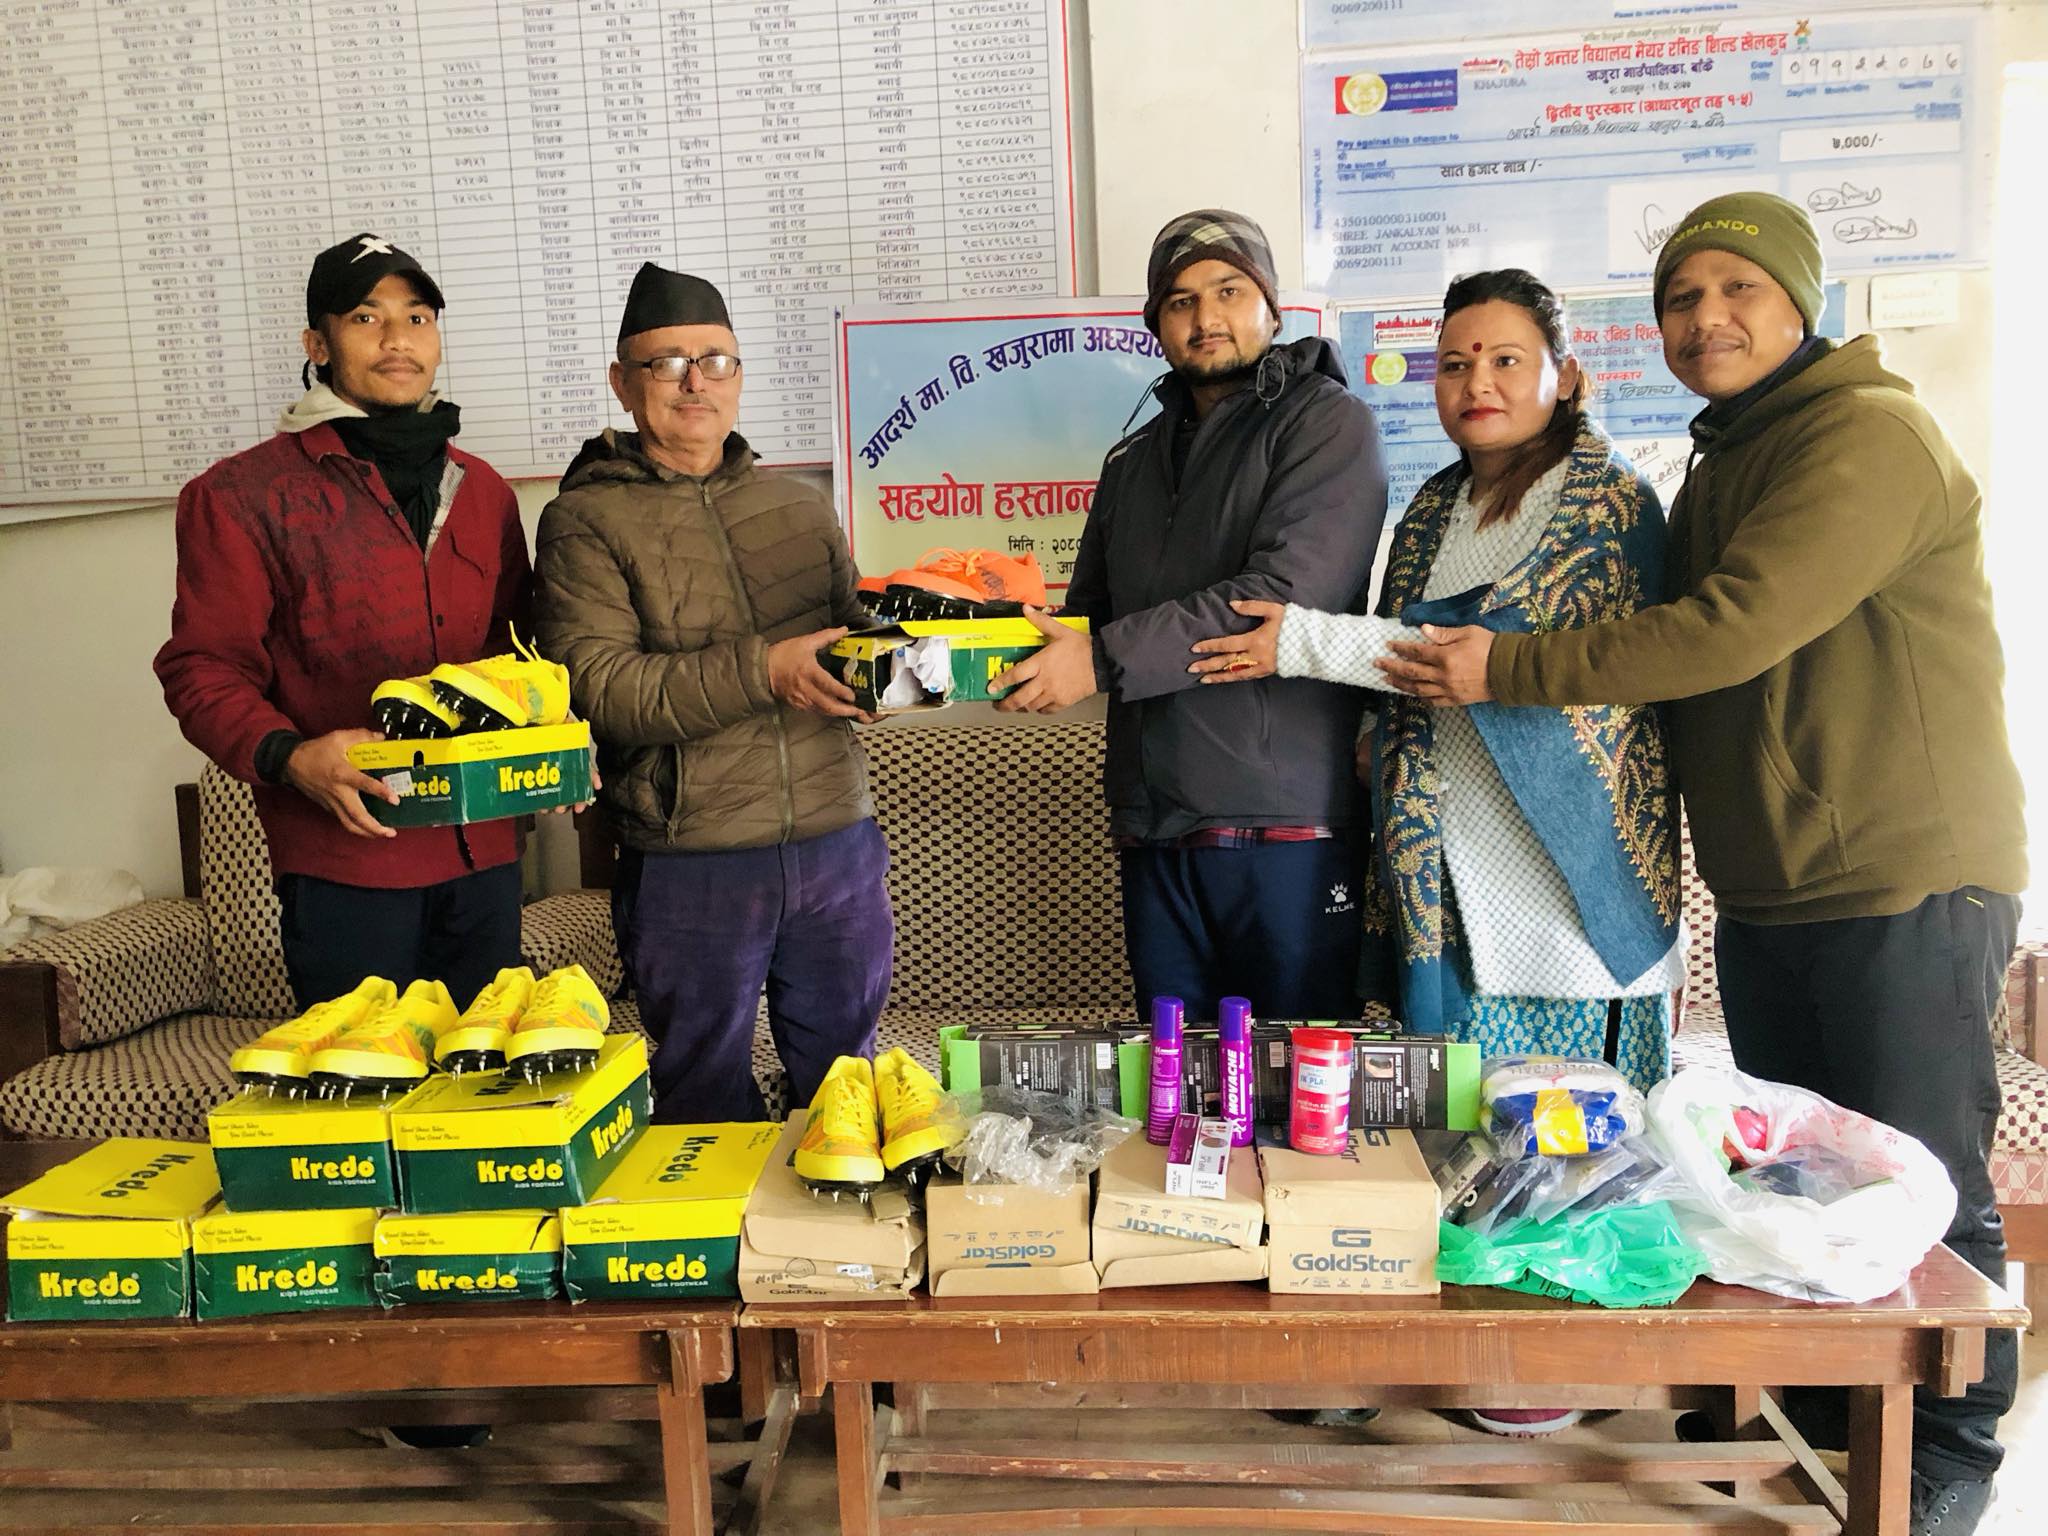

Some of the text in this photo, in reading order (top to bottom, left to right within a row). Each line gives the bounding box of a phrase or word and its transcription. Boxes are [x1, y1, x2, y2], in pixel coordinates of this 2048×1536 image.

[1585, 101, 1634, 121] पुरस्कार
[859, 396, 918, 470] आदर्श
[915, 377, 950, 412] मा.
[949, 354, 981, 390] वि.
[983, 327, 1076, 373] खजुरामा
[878, 472, 985, 523] सहयोग
[1008, 536, 1035, 553] मिति
[499, 762, 561, 793] Kredo
[1325, 903, 1355, 914] KELME
[1227, 1049, 1239, 1115] MOVACHE
[590, 1103, 634, 1161] Kredo
[290, 1155, 376, 1180] Kredo
[477, 1158, 564, 1184] Kredo
[659, 1135, 720, 1184] Kredo
[101, 1152, 198, 1200] Kredo
[961, 1244, 1057, 1260] GoldStar
[1292, 1253, 1411, 1273] GoldStar
[236, 1260, 339, 1293] Kredo
[416, 1267, 519, 1292] Kredo
[607, 1253, 707, 1283] Kredo
[40, 1271, 141, 1299] Kredo
